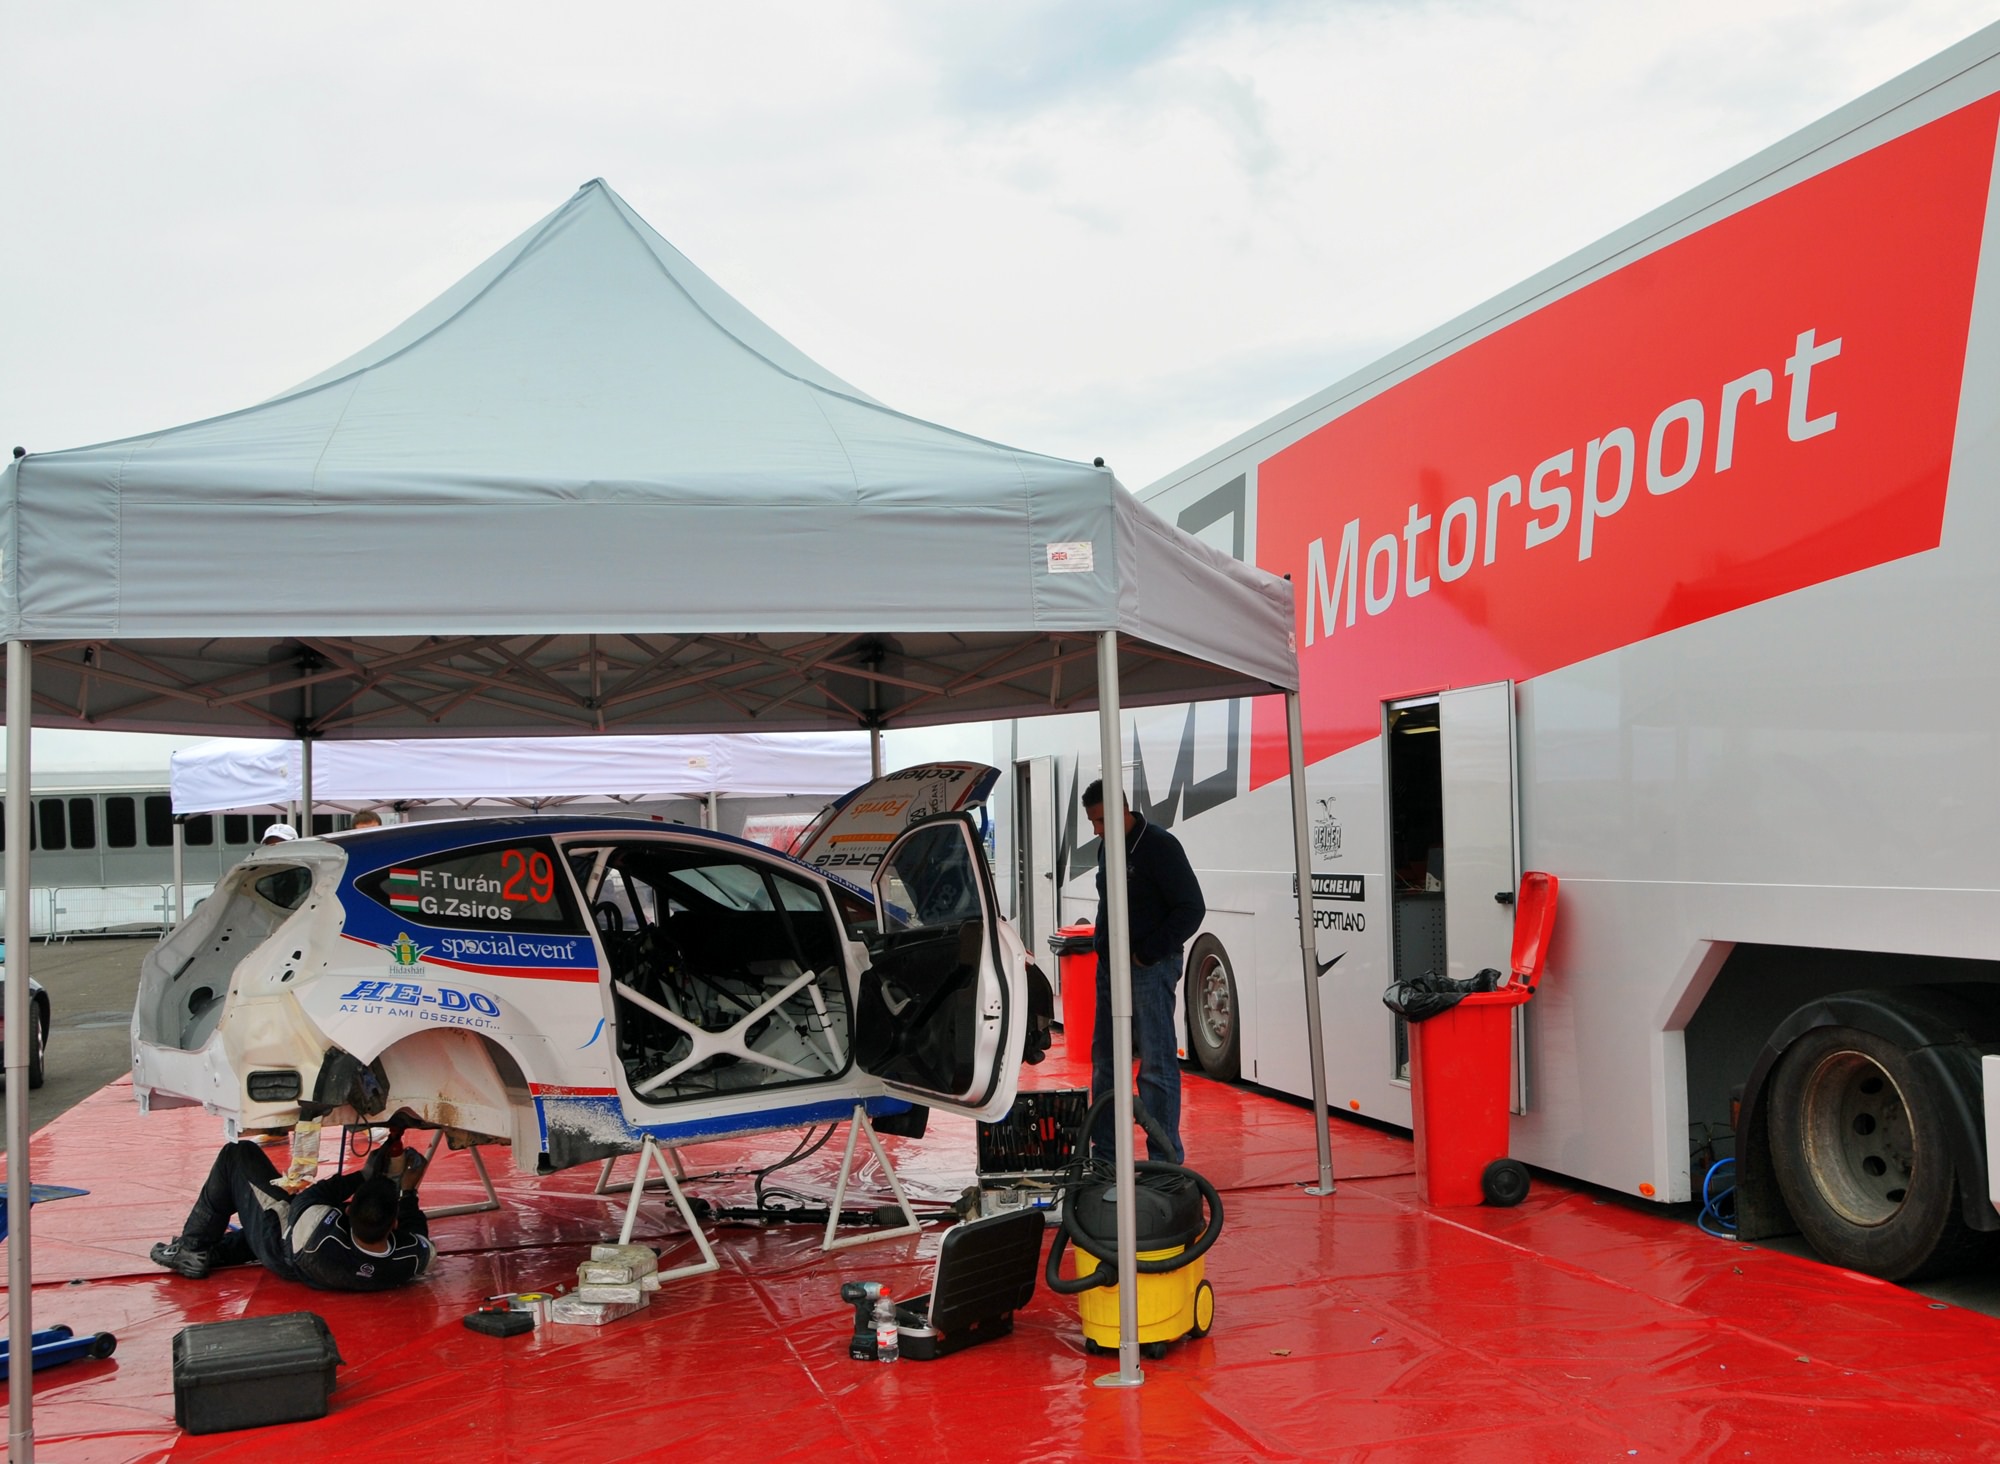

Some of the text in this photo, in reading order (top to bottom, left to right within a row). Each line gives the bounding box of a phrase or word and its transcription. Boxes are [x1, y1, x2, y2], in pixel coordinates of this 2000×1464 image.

[1304, 327, 1842, 648] Motorsport
[501, 849, 554, 904] 29
[1312, 878, 1362, 894] MICHELIN
[420, 896, 512, 920] G.Zsiros
[339, 1004, 357, 1013] AZ
[365, 1003, 384, 1014] ÚT
[388, 1008, 413, 1018] AMI
[340, 980, 500, 1017] HE-DO
